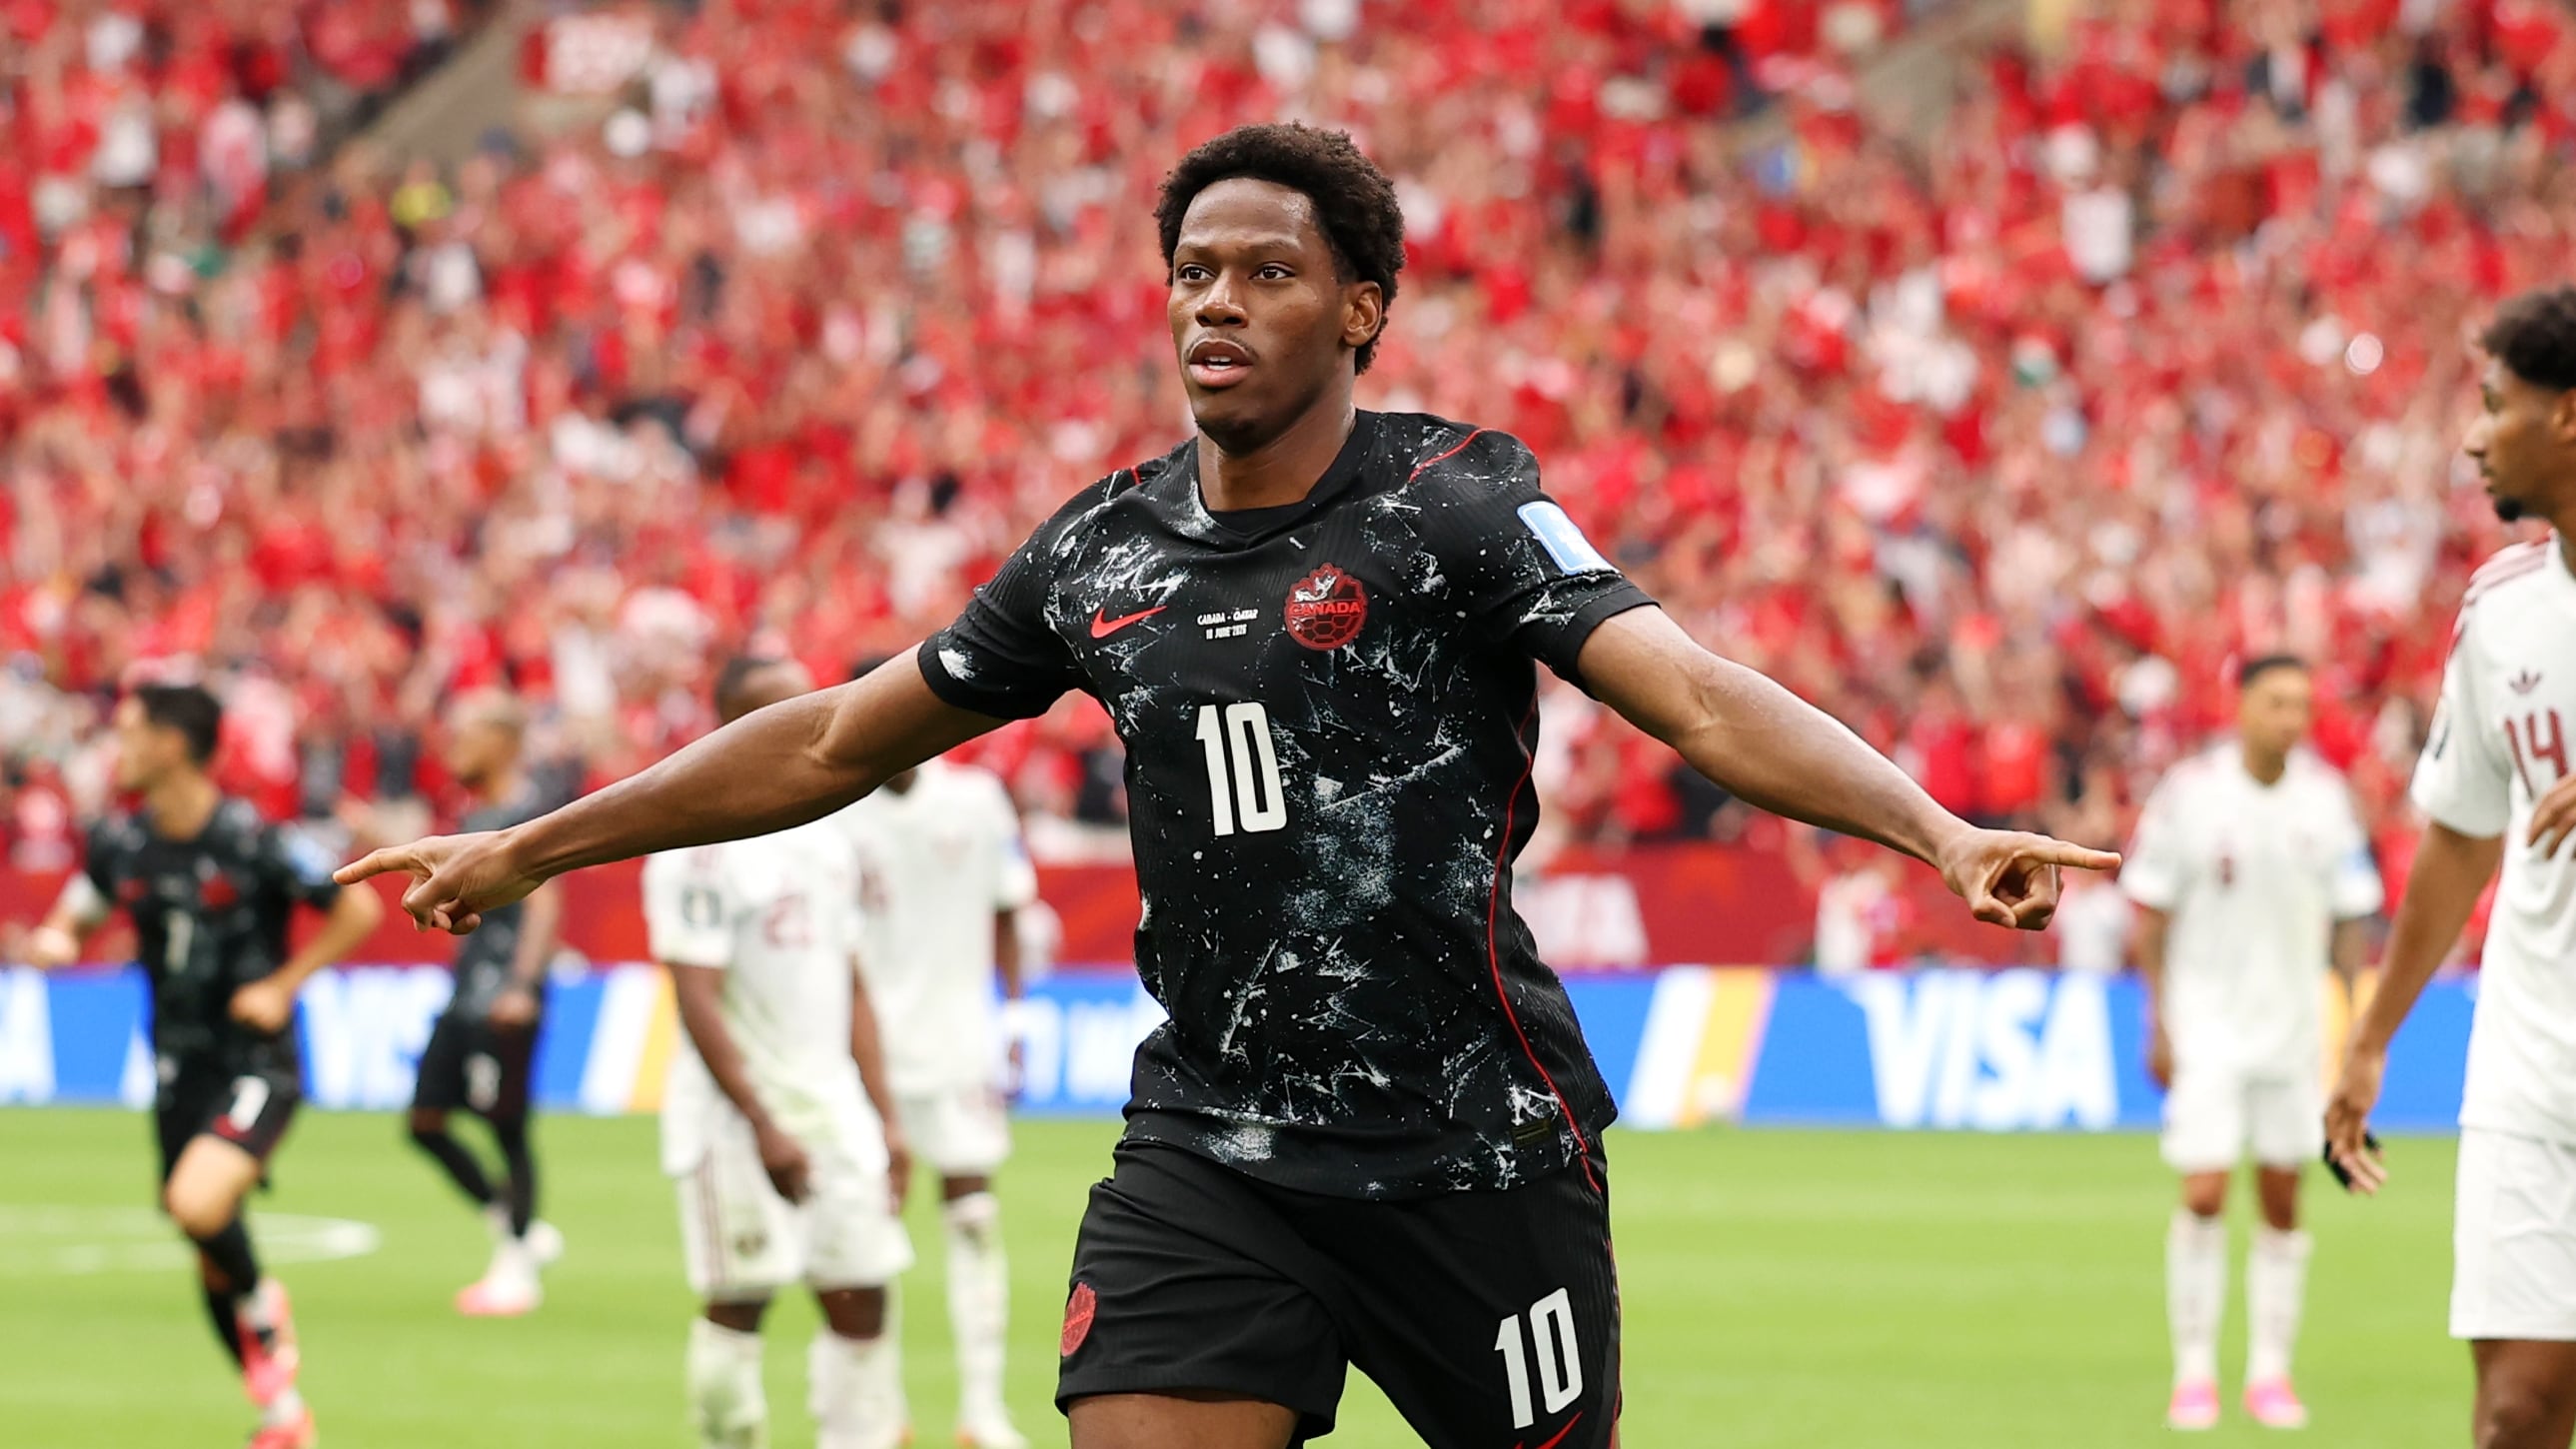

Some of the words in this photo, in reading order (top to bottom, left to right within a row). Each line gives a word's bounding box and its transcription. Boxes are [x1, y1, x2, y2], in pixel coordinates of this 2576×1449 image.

[1197, 612, 1226, 626] CANADA
[1232, 609, 1259, 622] QATAR
[1214, 626, 1231, 640] JUNE
[1289, 601, 1361, 617] CANADA
[1195, 702, 1287, 836] 10
[2504, 709, 2569, 800] 14
[1844, 969, 2119, 1130] VISA
[1494, 1286, 1583, 1430] 10
